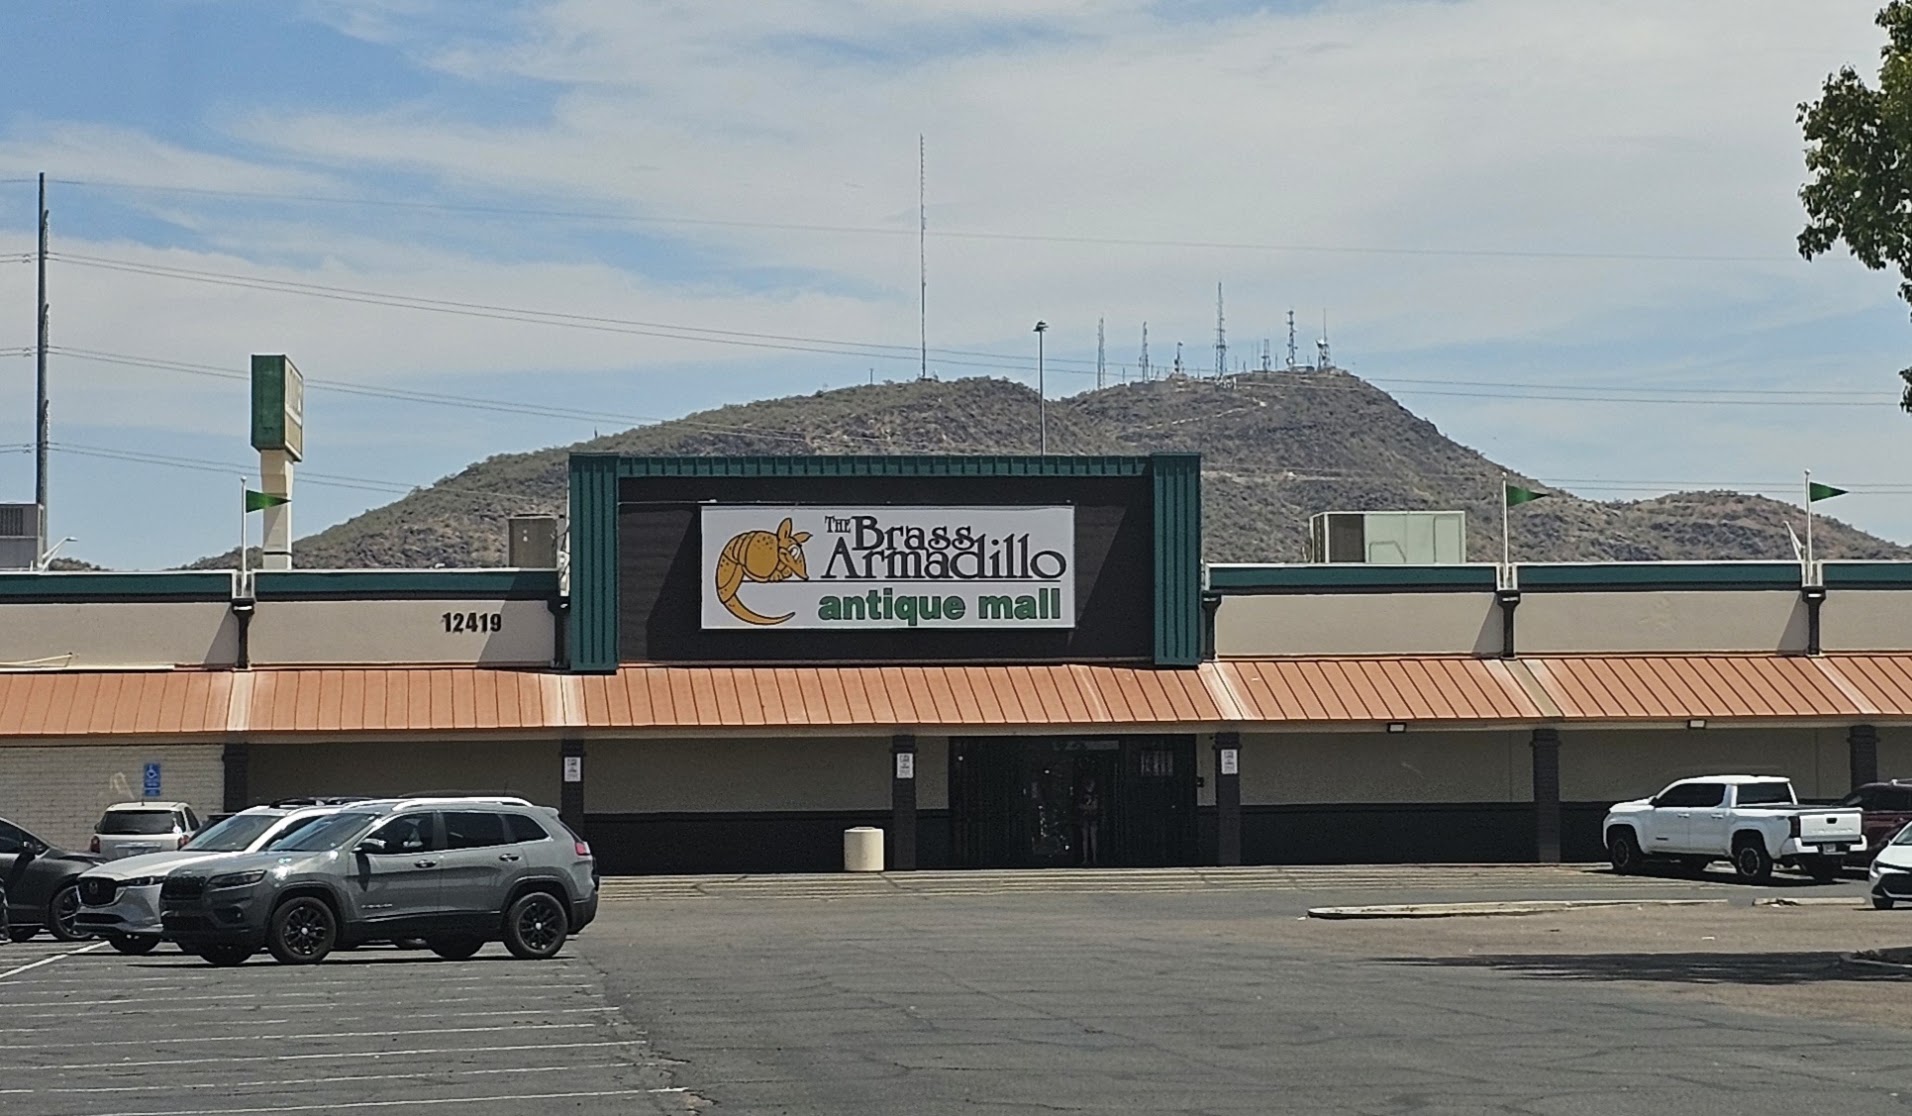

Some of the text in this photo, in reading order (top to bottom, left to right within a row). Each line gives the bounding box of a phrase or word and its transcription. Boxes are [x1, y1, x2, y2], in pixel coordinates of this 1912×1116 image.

[824, 515, 975, 551] THE Brass
[820, 533, 1067, 579] Armadillo
[442, 612, 502, 633] 12419
[818, 587, 1061, 626] antique mall
